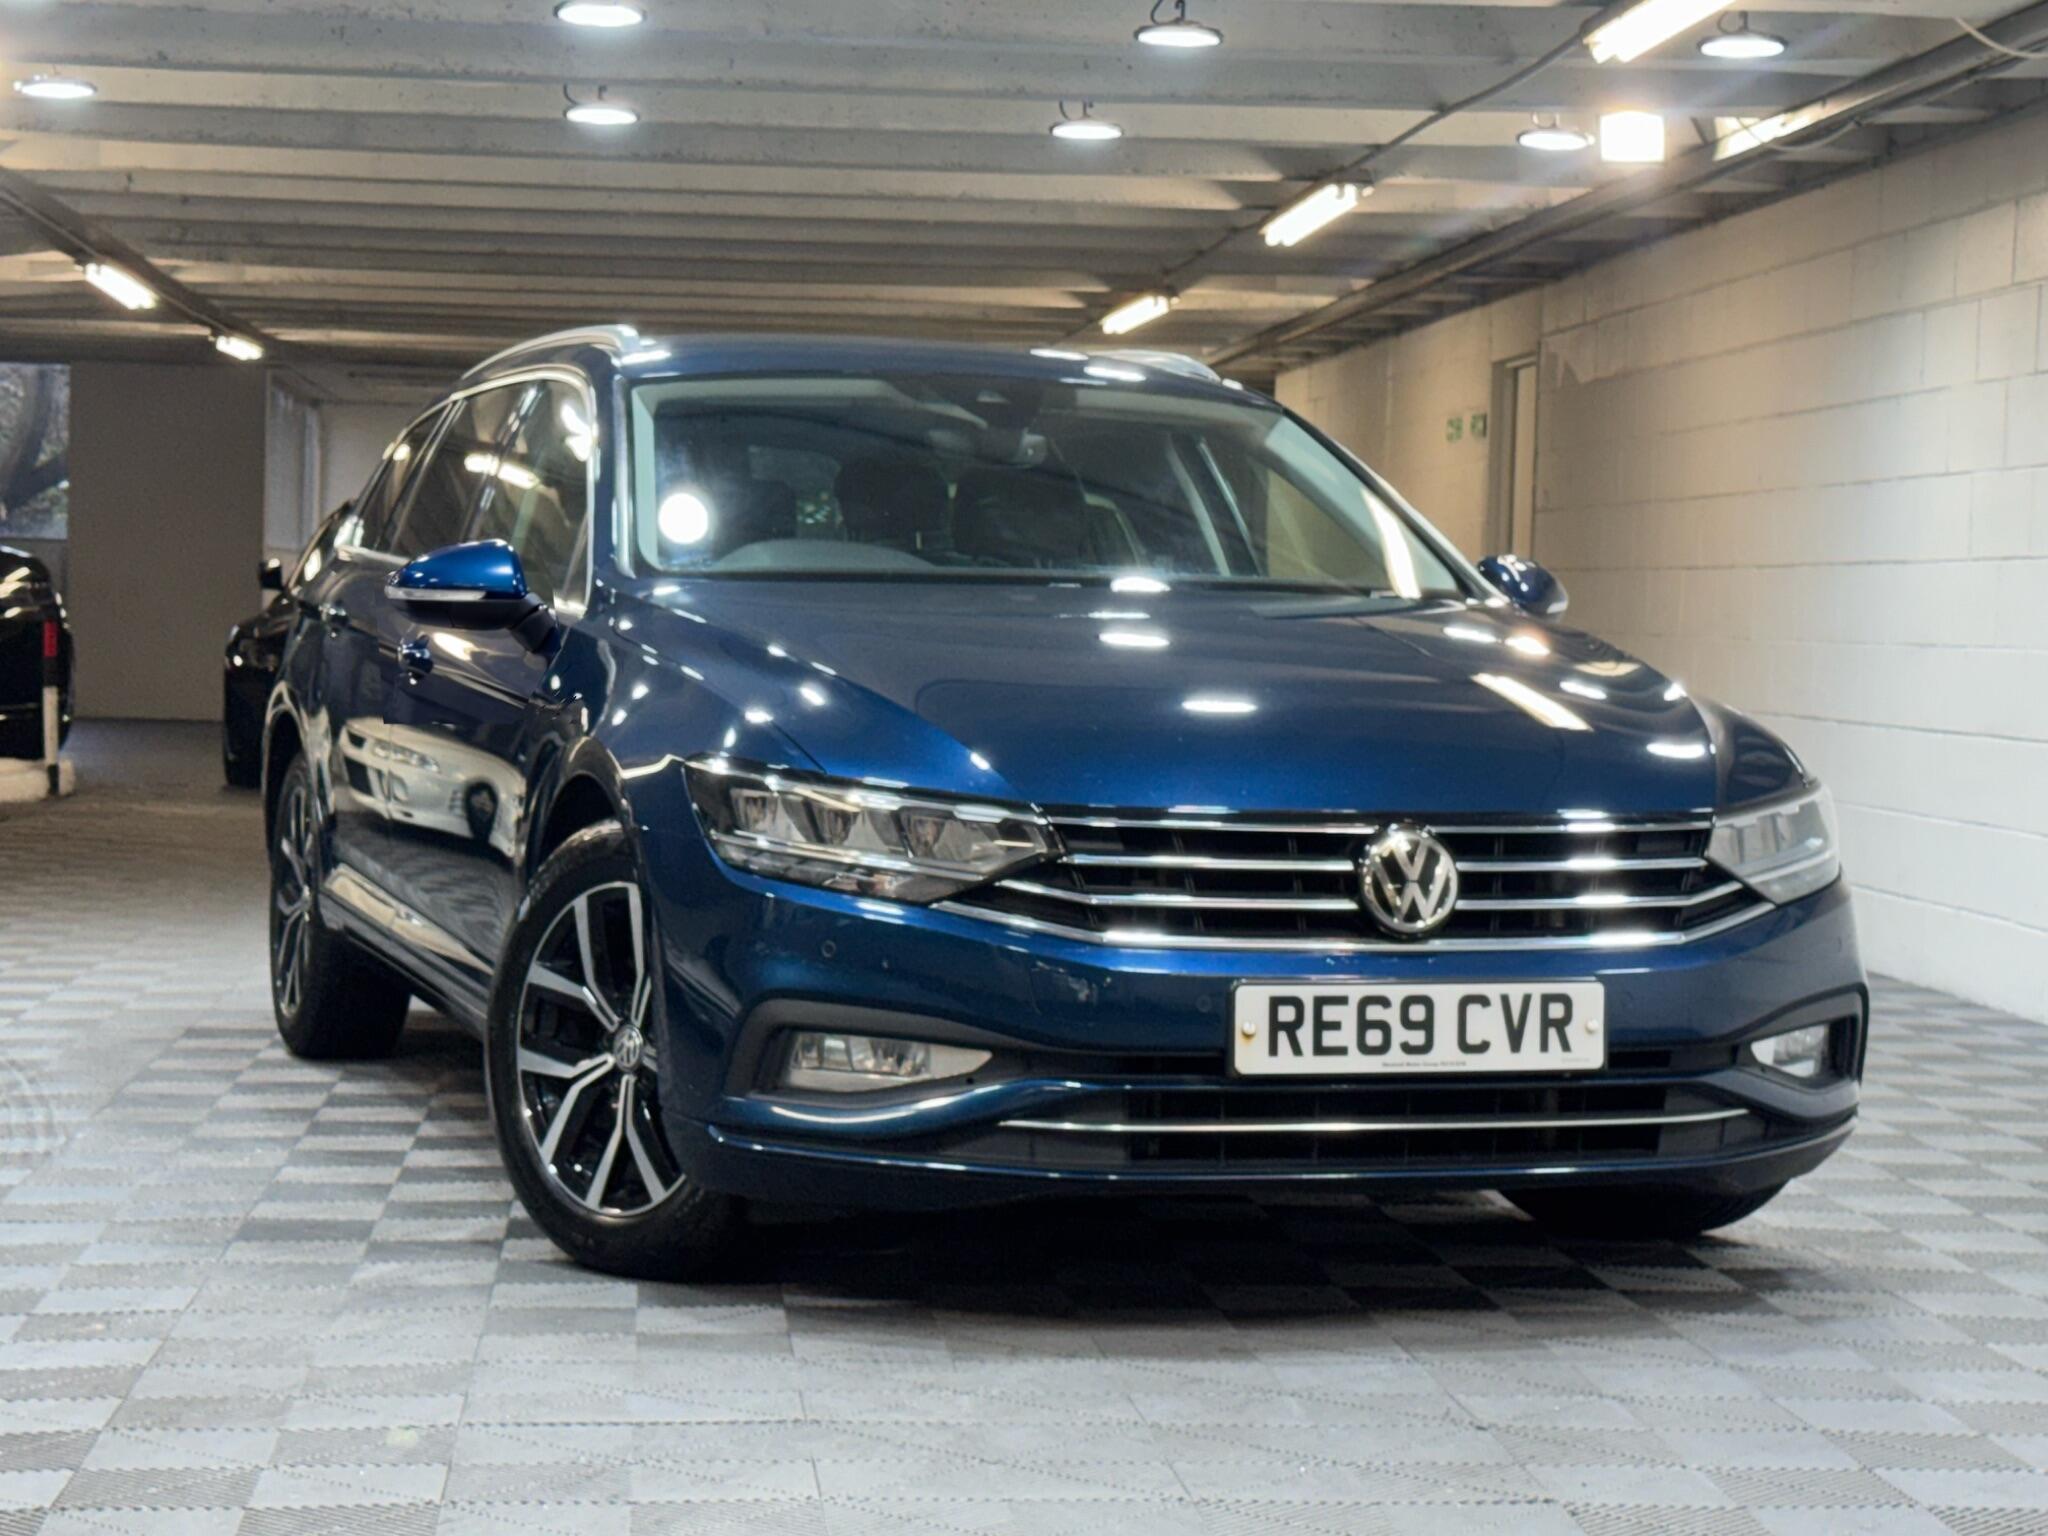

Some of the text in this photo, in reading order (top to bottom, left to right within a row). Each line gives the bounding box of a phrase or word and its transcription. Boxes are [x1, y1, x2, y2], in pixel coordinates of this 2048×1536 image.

[1363, 828, 1456, 932] VW
[1268, 992, 1574, 1057] RE69 CVR
